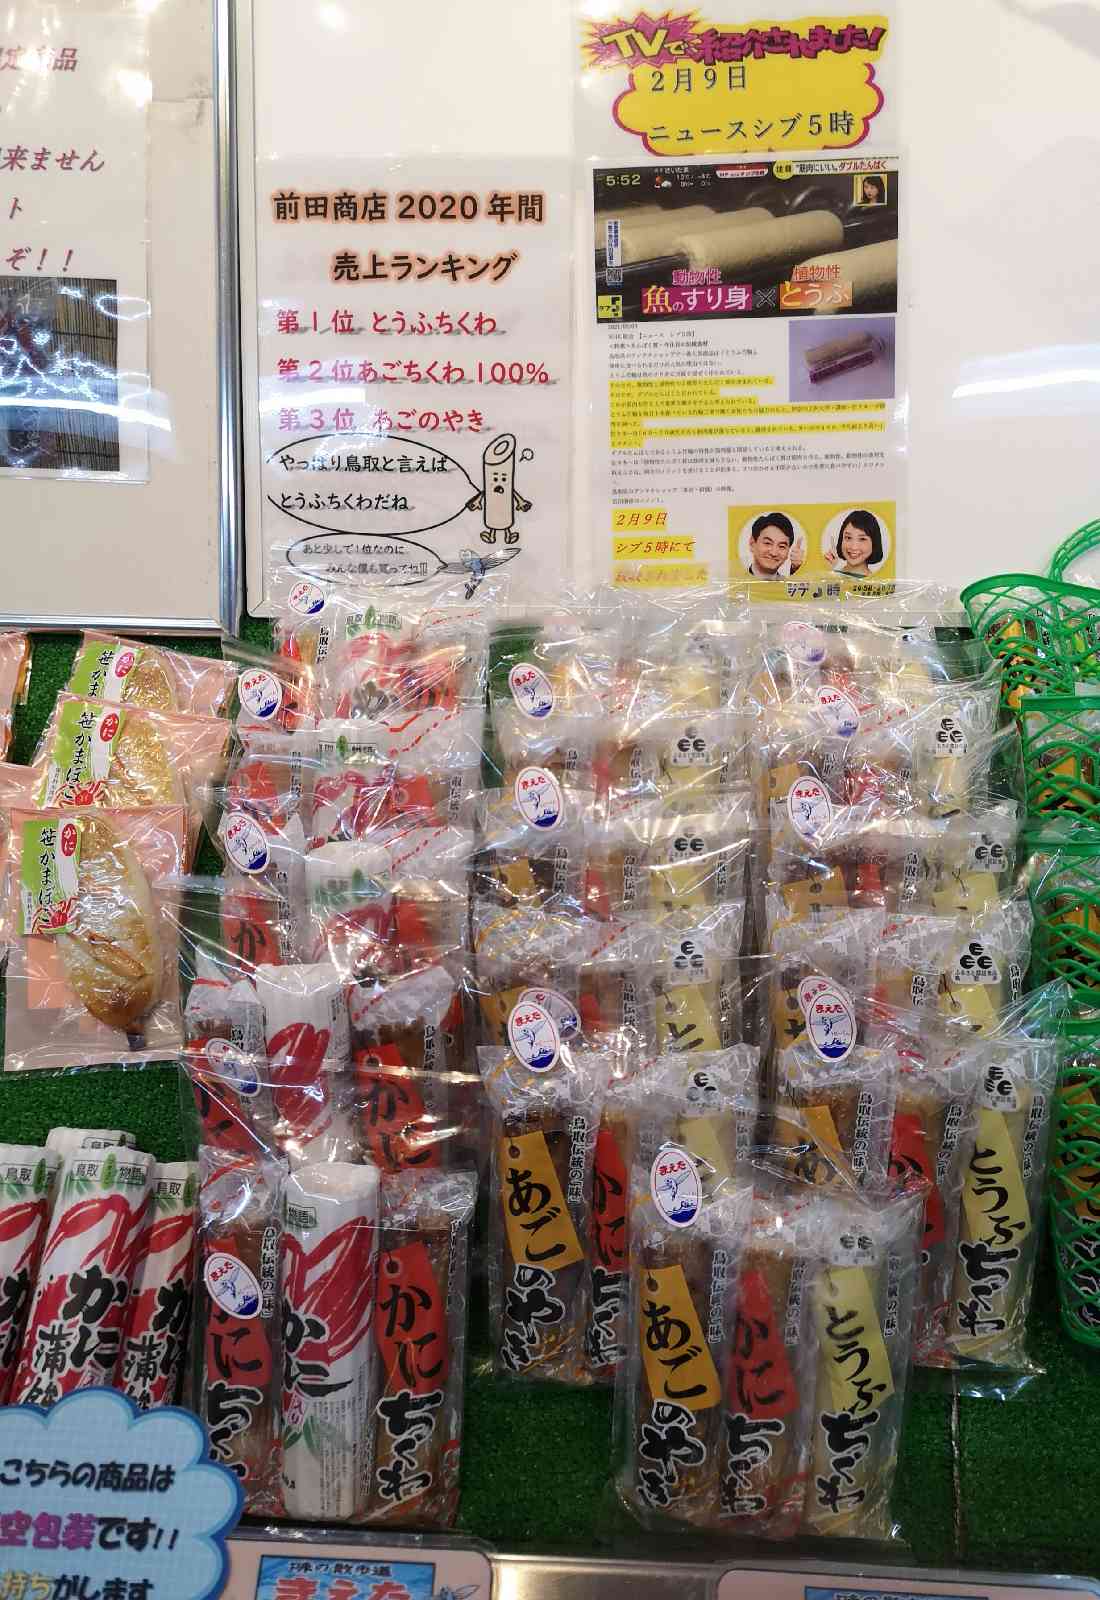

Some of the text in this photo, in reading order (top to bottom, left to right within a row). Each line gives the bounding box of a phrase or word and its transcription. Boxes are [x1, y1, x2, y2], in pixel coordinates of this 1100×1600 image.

[651, 65, 747, 93] 2月9日
[606, 174, 641, 186] 5:52
[273, 192, 544, 223] 前田商店 2020 年間
[332, 252, 518, 282] 売上ランキング
[643, 285, 750, 313] 魚のすり身
[780, 281, 849, 306] とうふ
[372, 311, 497, 334] とうふちくわ
[477, 361, 549, 383] 100%
[280, 494, 408, 511] とうふちくわだね
[616, 511, 668, 527] 2月9日
[87, 650, 114, 697] 笹かま
[116, 653, 134, 677] かに
[101, 714, 119, 741] かに
[63, 711, 97, 800] 笹かまぼこ
[62, 827, 77, 856] かに
[38, 828, 57, 922] 笹かまぼこ
[515, 1011, 542, 1027] まえた
[816, 1004, 843, 1013] まえた
[6, 1167, 32, 1181] 鳥取
[77, 1162, 99, 1177] 鳥取
[659, 1160, 687, 1176] まえた
[155, 1183, 181, 1196] 鳥取
[969, 1147, 1026, 1248] とうふ
[508, 1168, 567, 1261] あご
[957, 1241, 1021, 1338] ちくわ
[62, 1264, 129, 1368] かに
[380, 1284, 439, 1388] かに
[643, 1300, 708, 1399] あご
[736, 1312, 783, 1412] かに
[825, 1304, 886, 1413] とうふ
[377, 1389, 446, 1501] ちくわ
[637, 1400, 706, 1508] のやき
[1, 1458, 176, 1492] こちらの商品は
[720, 1413, 785, 1518] ちくわ
[815, 1409, 880, 1513] ちくわ
